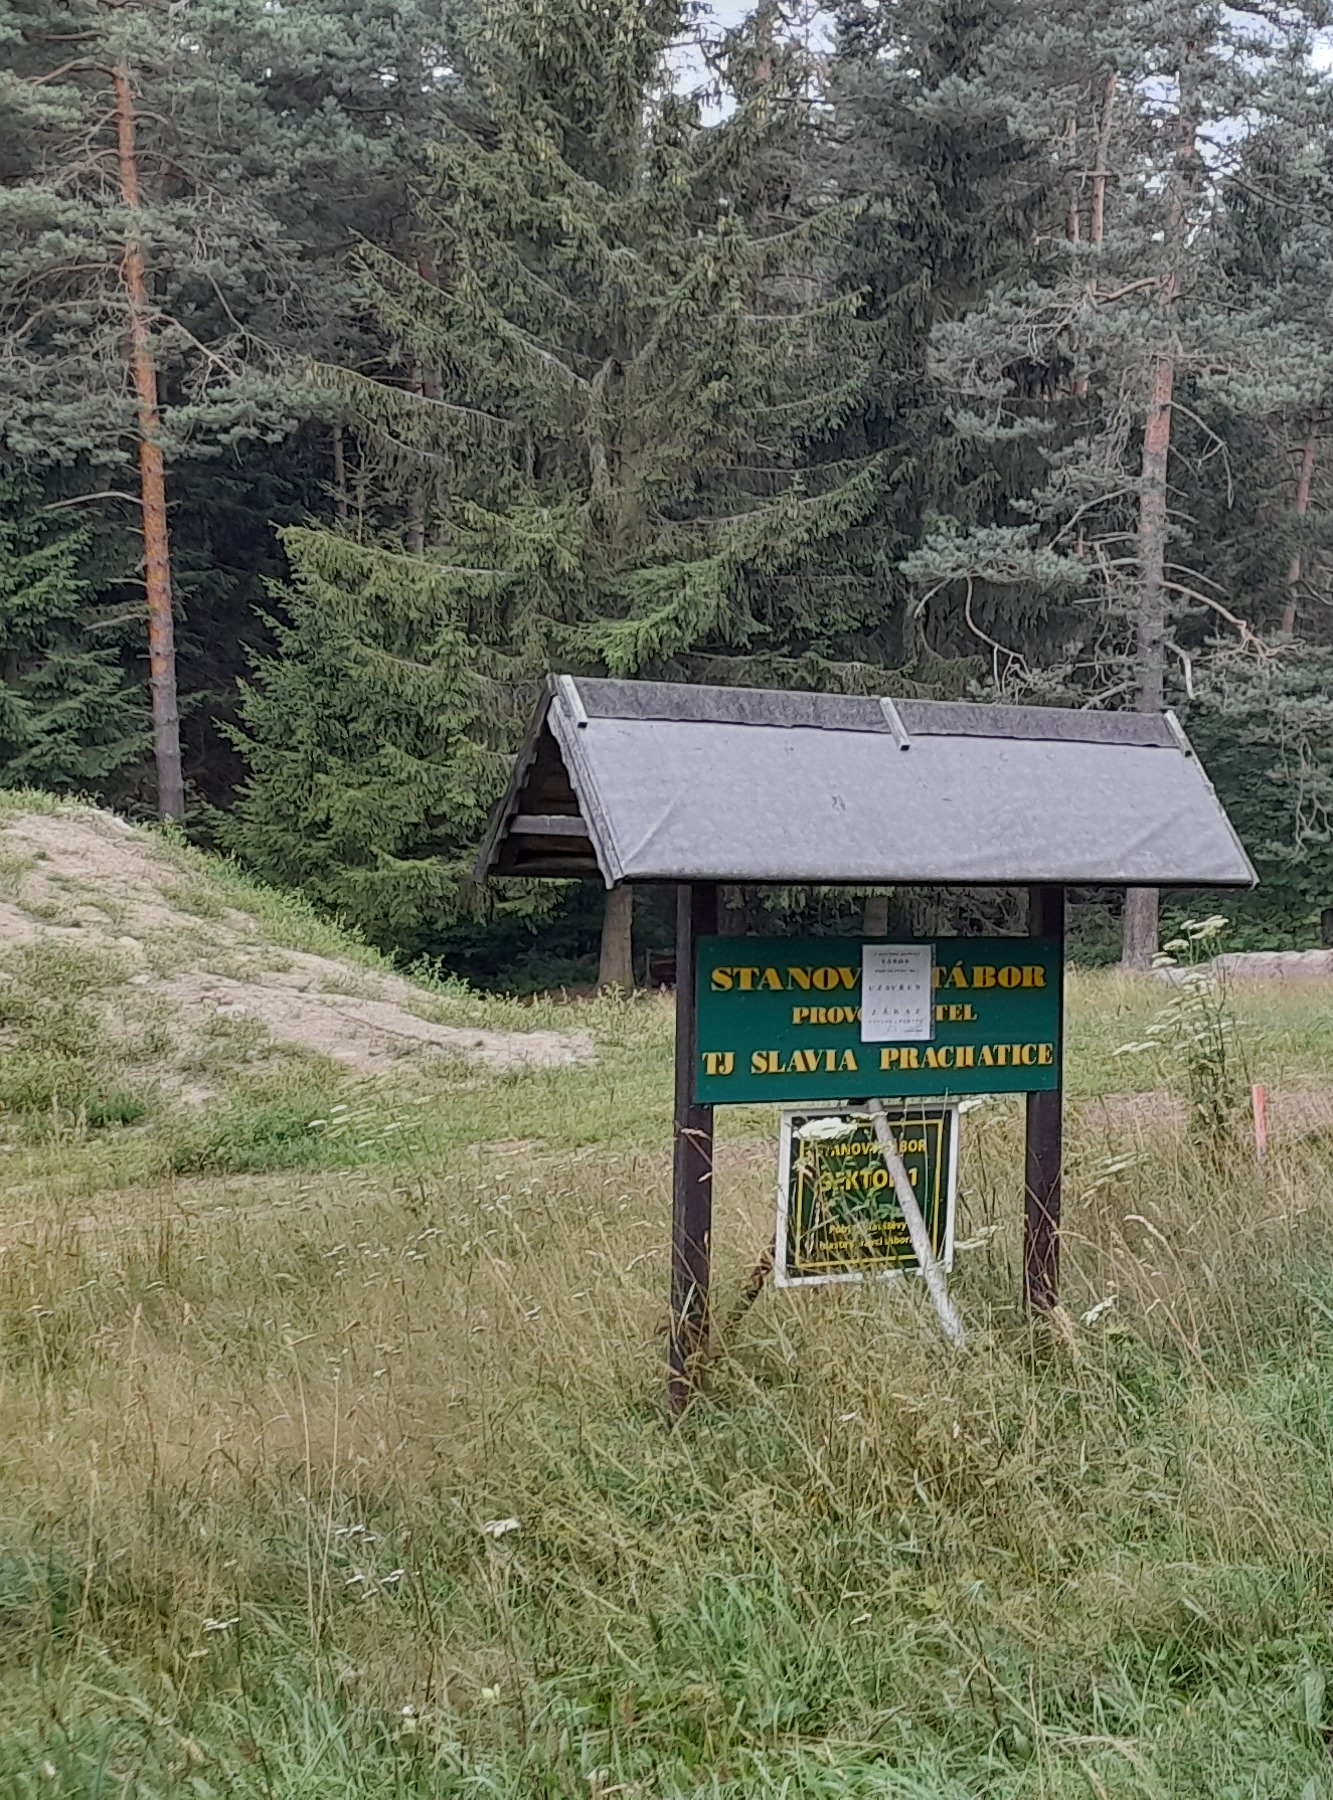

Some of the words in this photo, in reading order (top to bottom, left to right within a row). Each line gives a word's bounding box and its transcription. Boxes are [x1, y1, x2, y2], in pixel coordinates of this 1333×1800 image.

[710, 966, 864, 992] STANOV
[931, 959, 1047, 989] TÁBOR
[701, 1051, 736, 1076] TJ
[751, 1048, 859, 1075] SLAVIA
[879, 1043, 1053, 1071] PRACHATICE
[908, 1166, 918, 1187] 1
